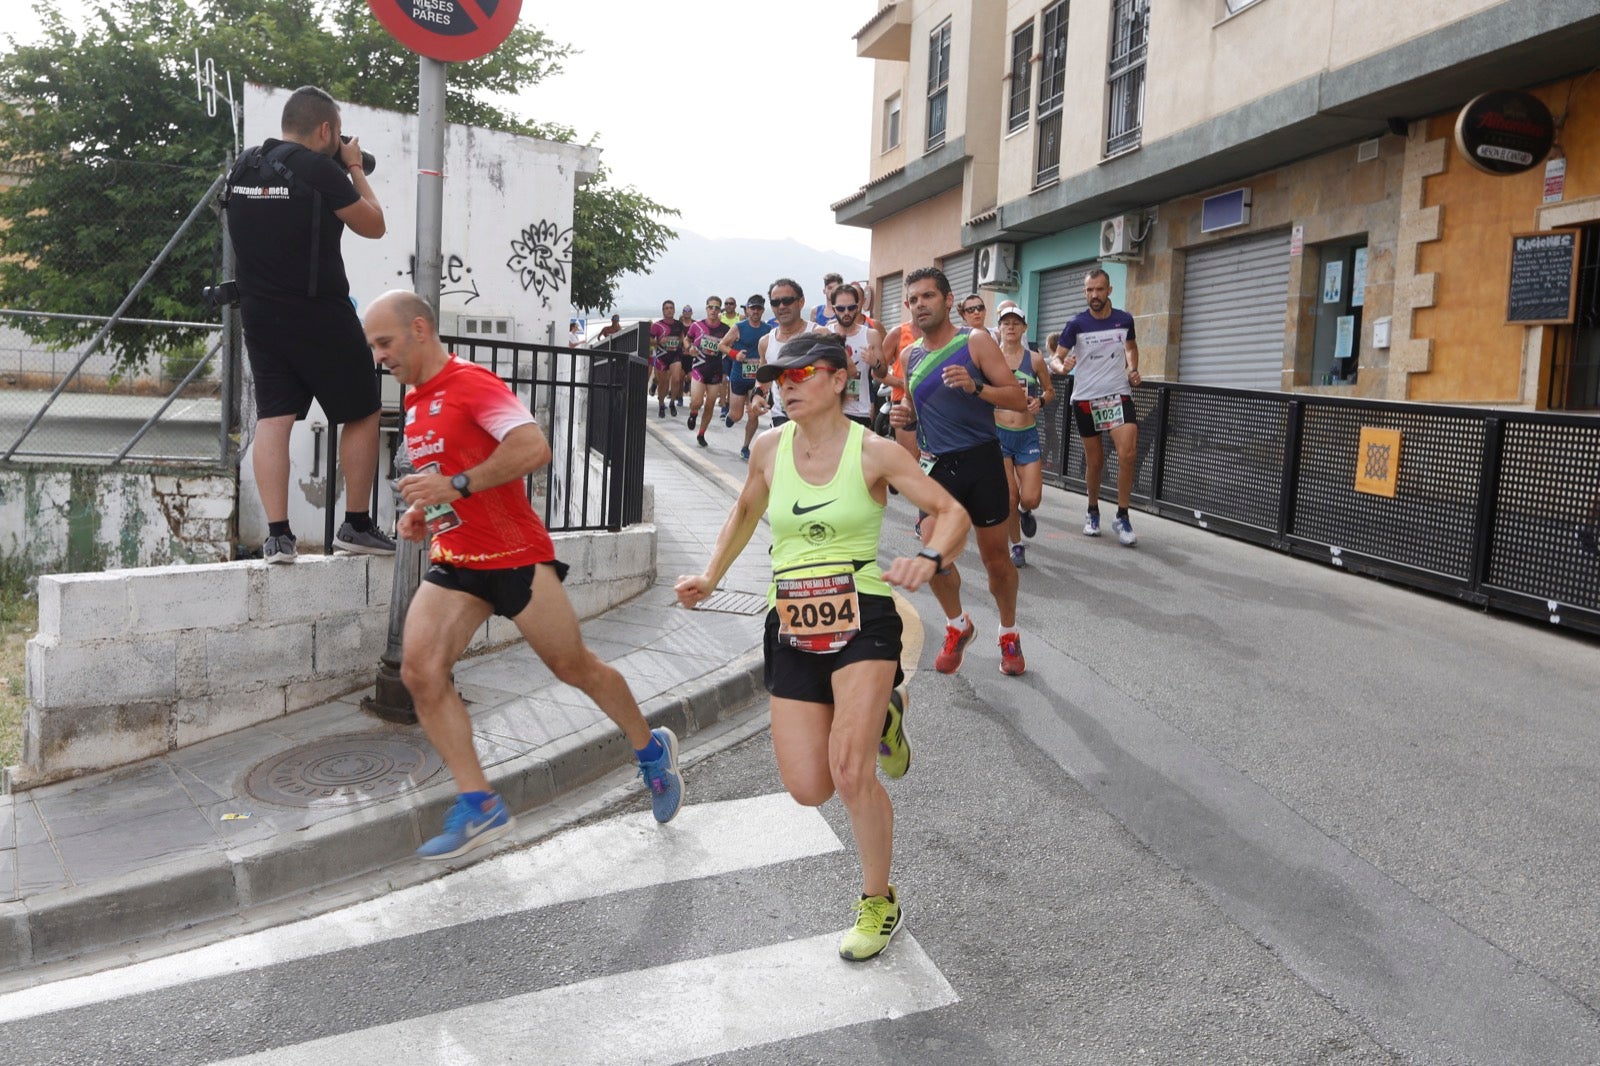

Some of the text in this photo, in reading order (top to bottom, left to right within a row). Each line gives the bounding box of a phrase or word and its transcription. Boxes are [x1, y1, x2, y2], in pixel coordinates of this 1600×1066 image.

[413, 0, 454, 12] MESES
[412, 8, 451, 25] PARES
[233, 186, 261, 195] cruzando
[269, 187, 289, 196] meta
[824, 577, 832, 588] DE
[787, 598, 854, 627] 2094
